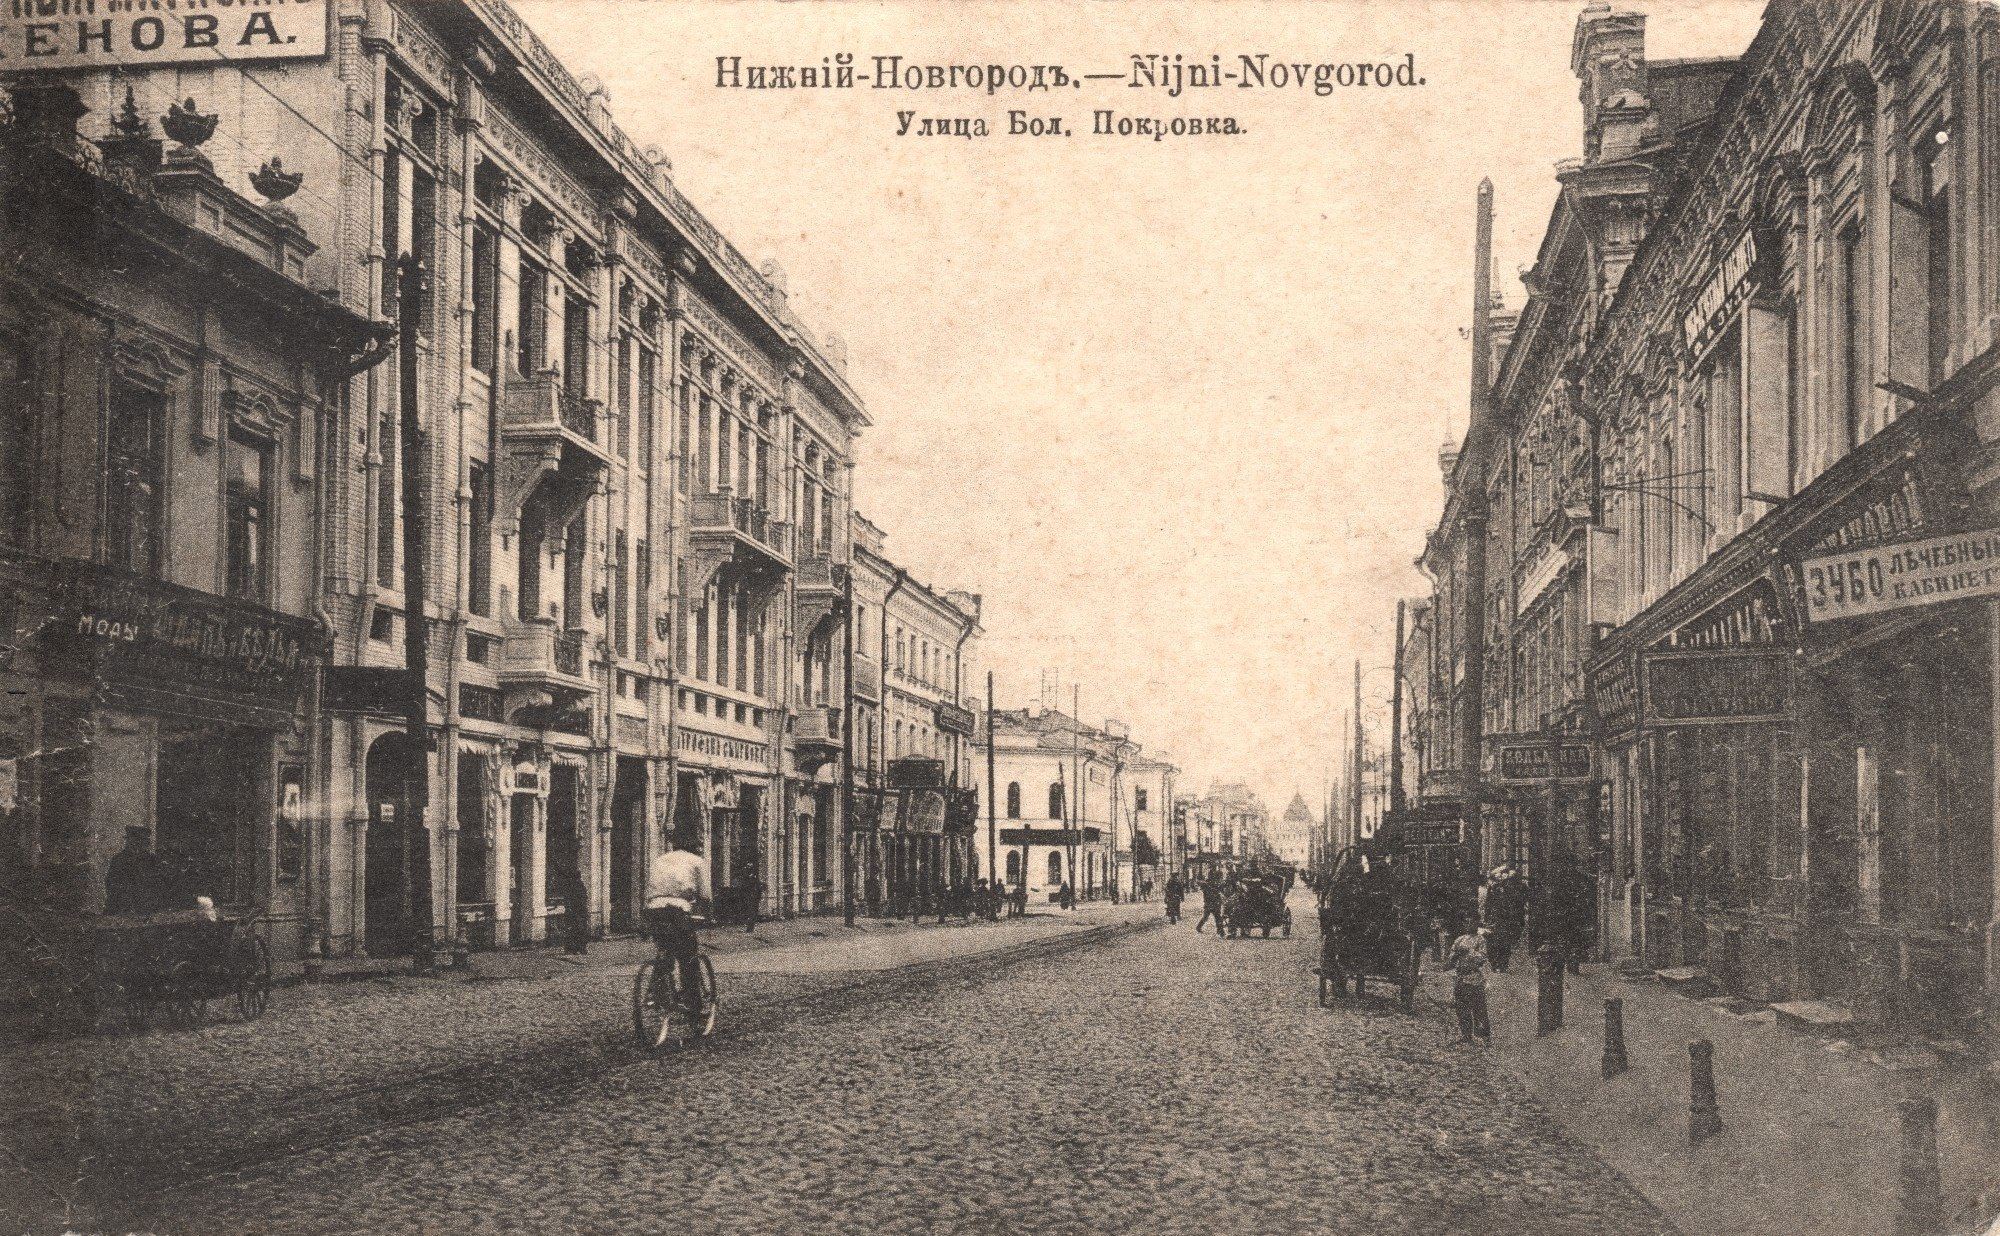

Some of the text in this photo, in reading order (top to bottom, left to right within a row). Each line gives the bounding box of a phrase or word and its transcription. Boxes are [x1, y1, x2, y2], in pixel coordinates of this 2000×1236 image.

[0, 11, 296, 58] ЕНОВА.
[1809, 557, 1884, 608] ЗУБО
[1894, 568, 2000, 599] КАБИНЕТ
